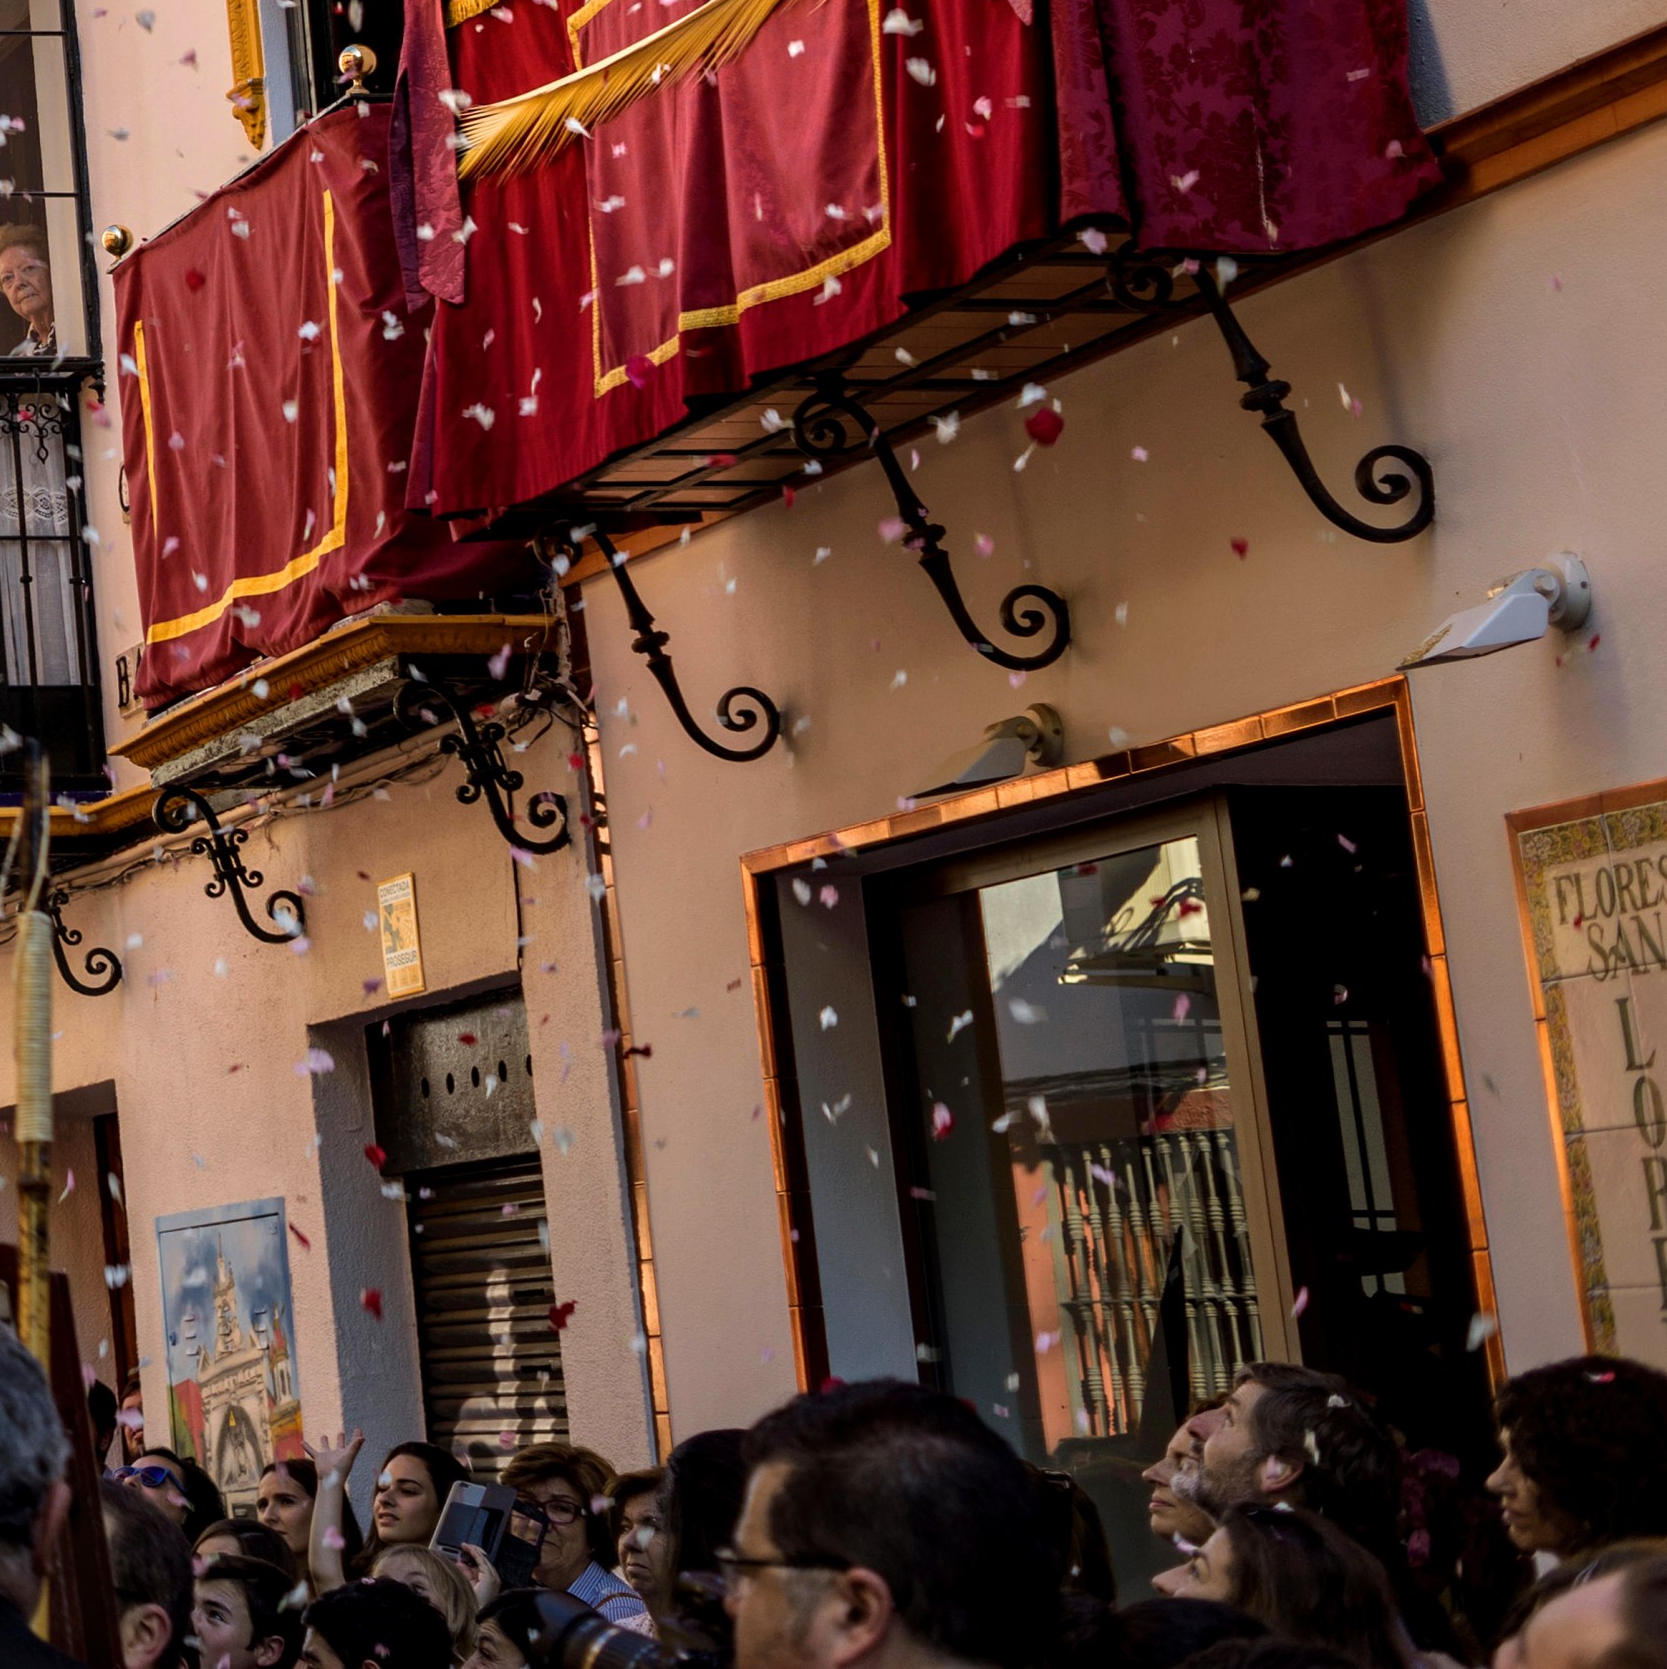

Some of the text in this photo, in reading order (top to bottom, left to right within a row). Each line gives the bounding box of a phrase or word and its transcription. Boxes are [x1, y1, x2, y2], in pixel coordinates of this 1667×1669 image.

[379, 881, 410, 898] CONECTADA
[1587, 911, 1667, 983] SAN
[385, 949, 417, 967] PROSEGUR
